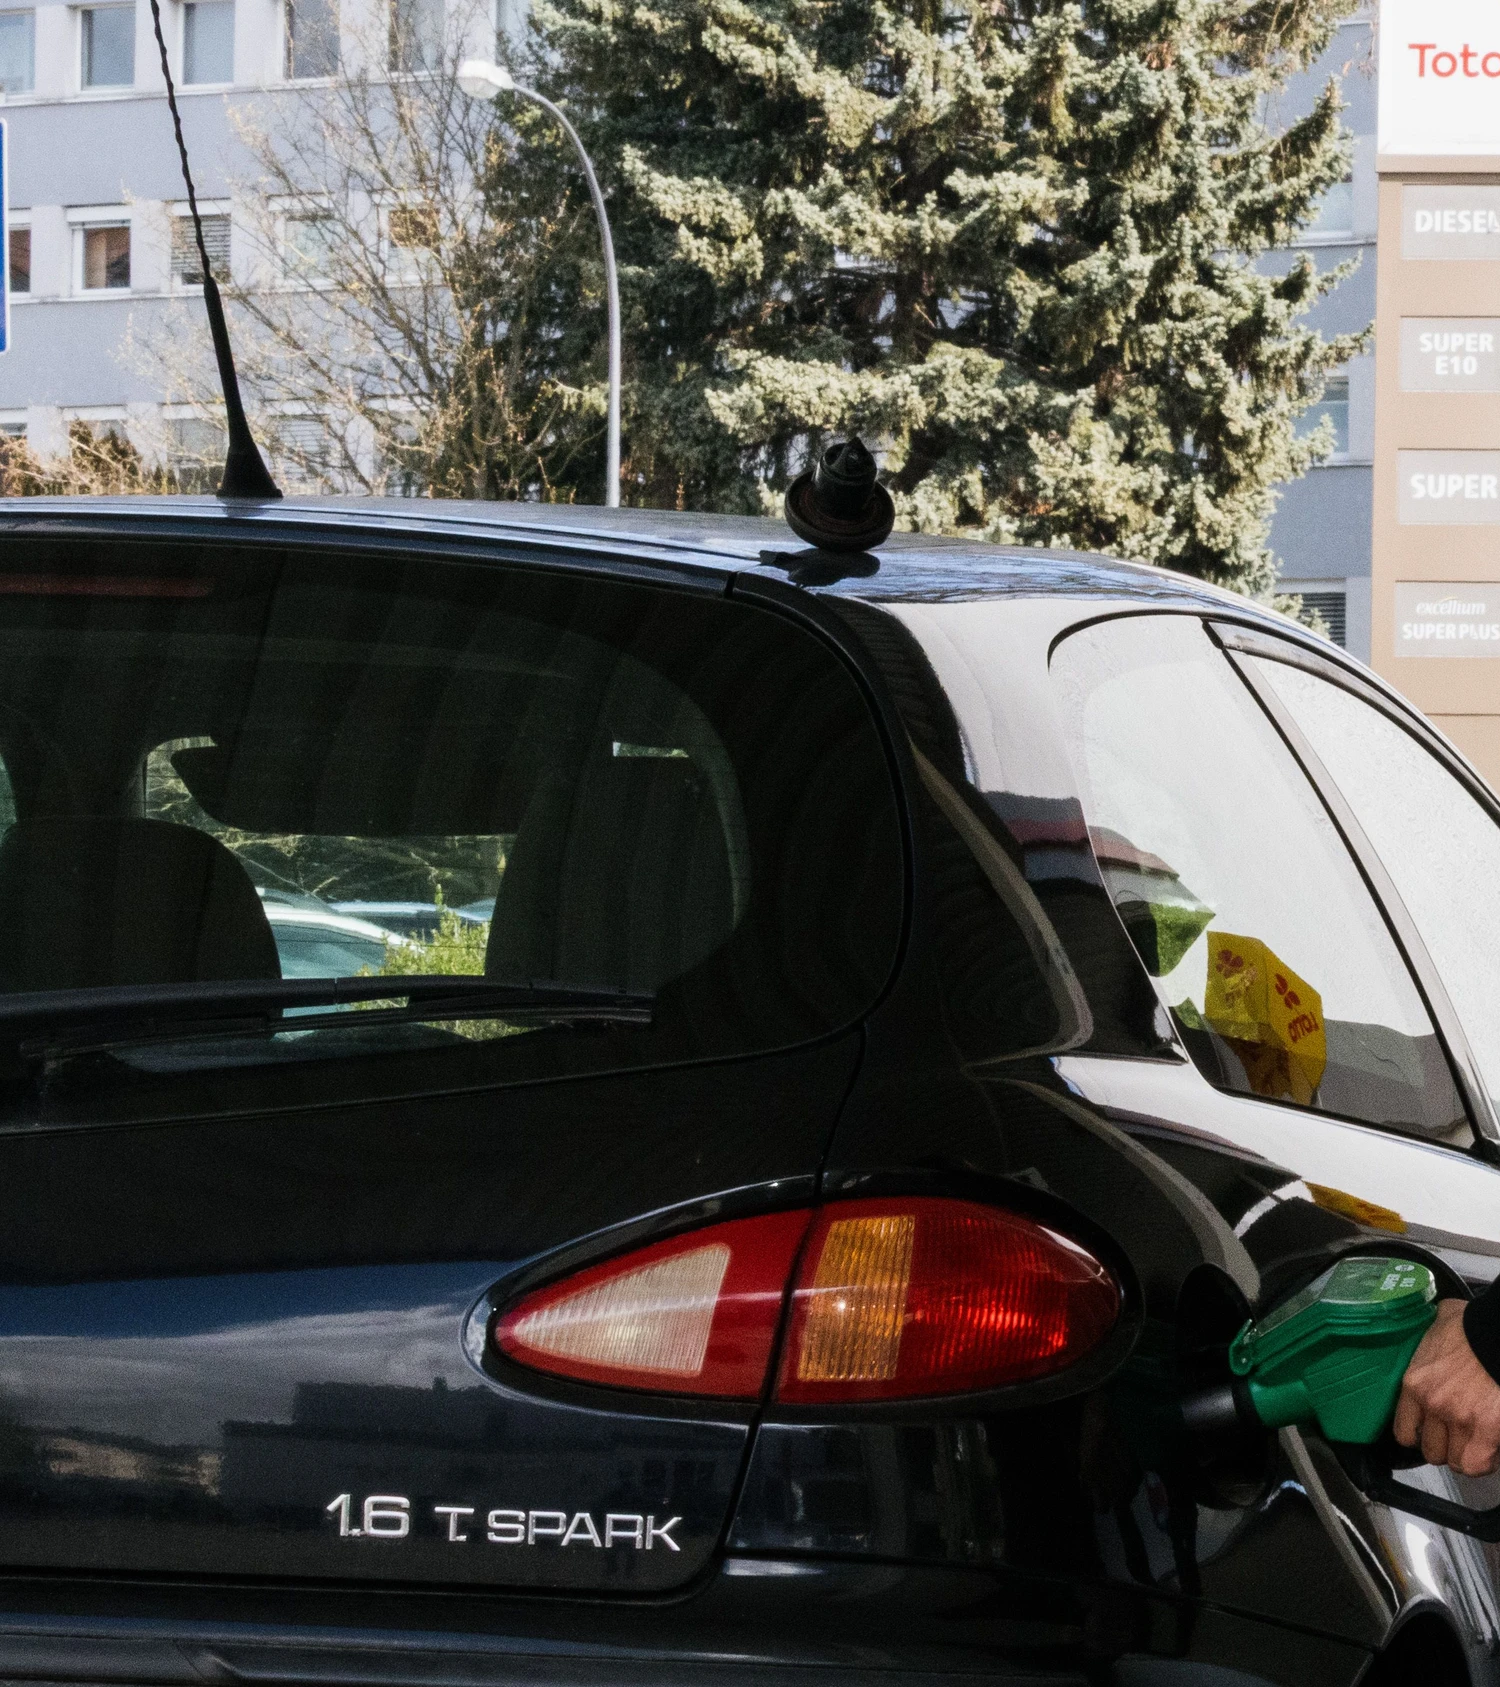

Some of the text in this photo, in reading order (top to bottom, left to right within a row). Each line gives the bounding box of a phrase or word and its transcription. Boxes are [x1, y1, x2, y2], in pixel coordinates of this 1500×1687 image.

[1420, 332, 1494, 353] SUPER
[1435, 356, 1478, 375] E10
[1410, 474, 1498, 499] SUPER
[1416, 600, 1487, 615] excellium
[327, 1493, 410, 1538] 1.6
[488, 1510, 683, 1551] SPARK
